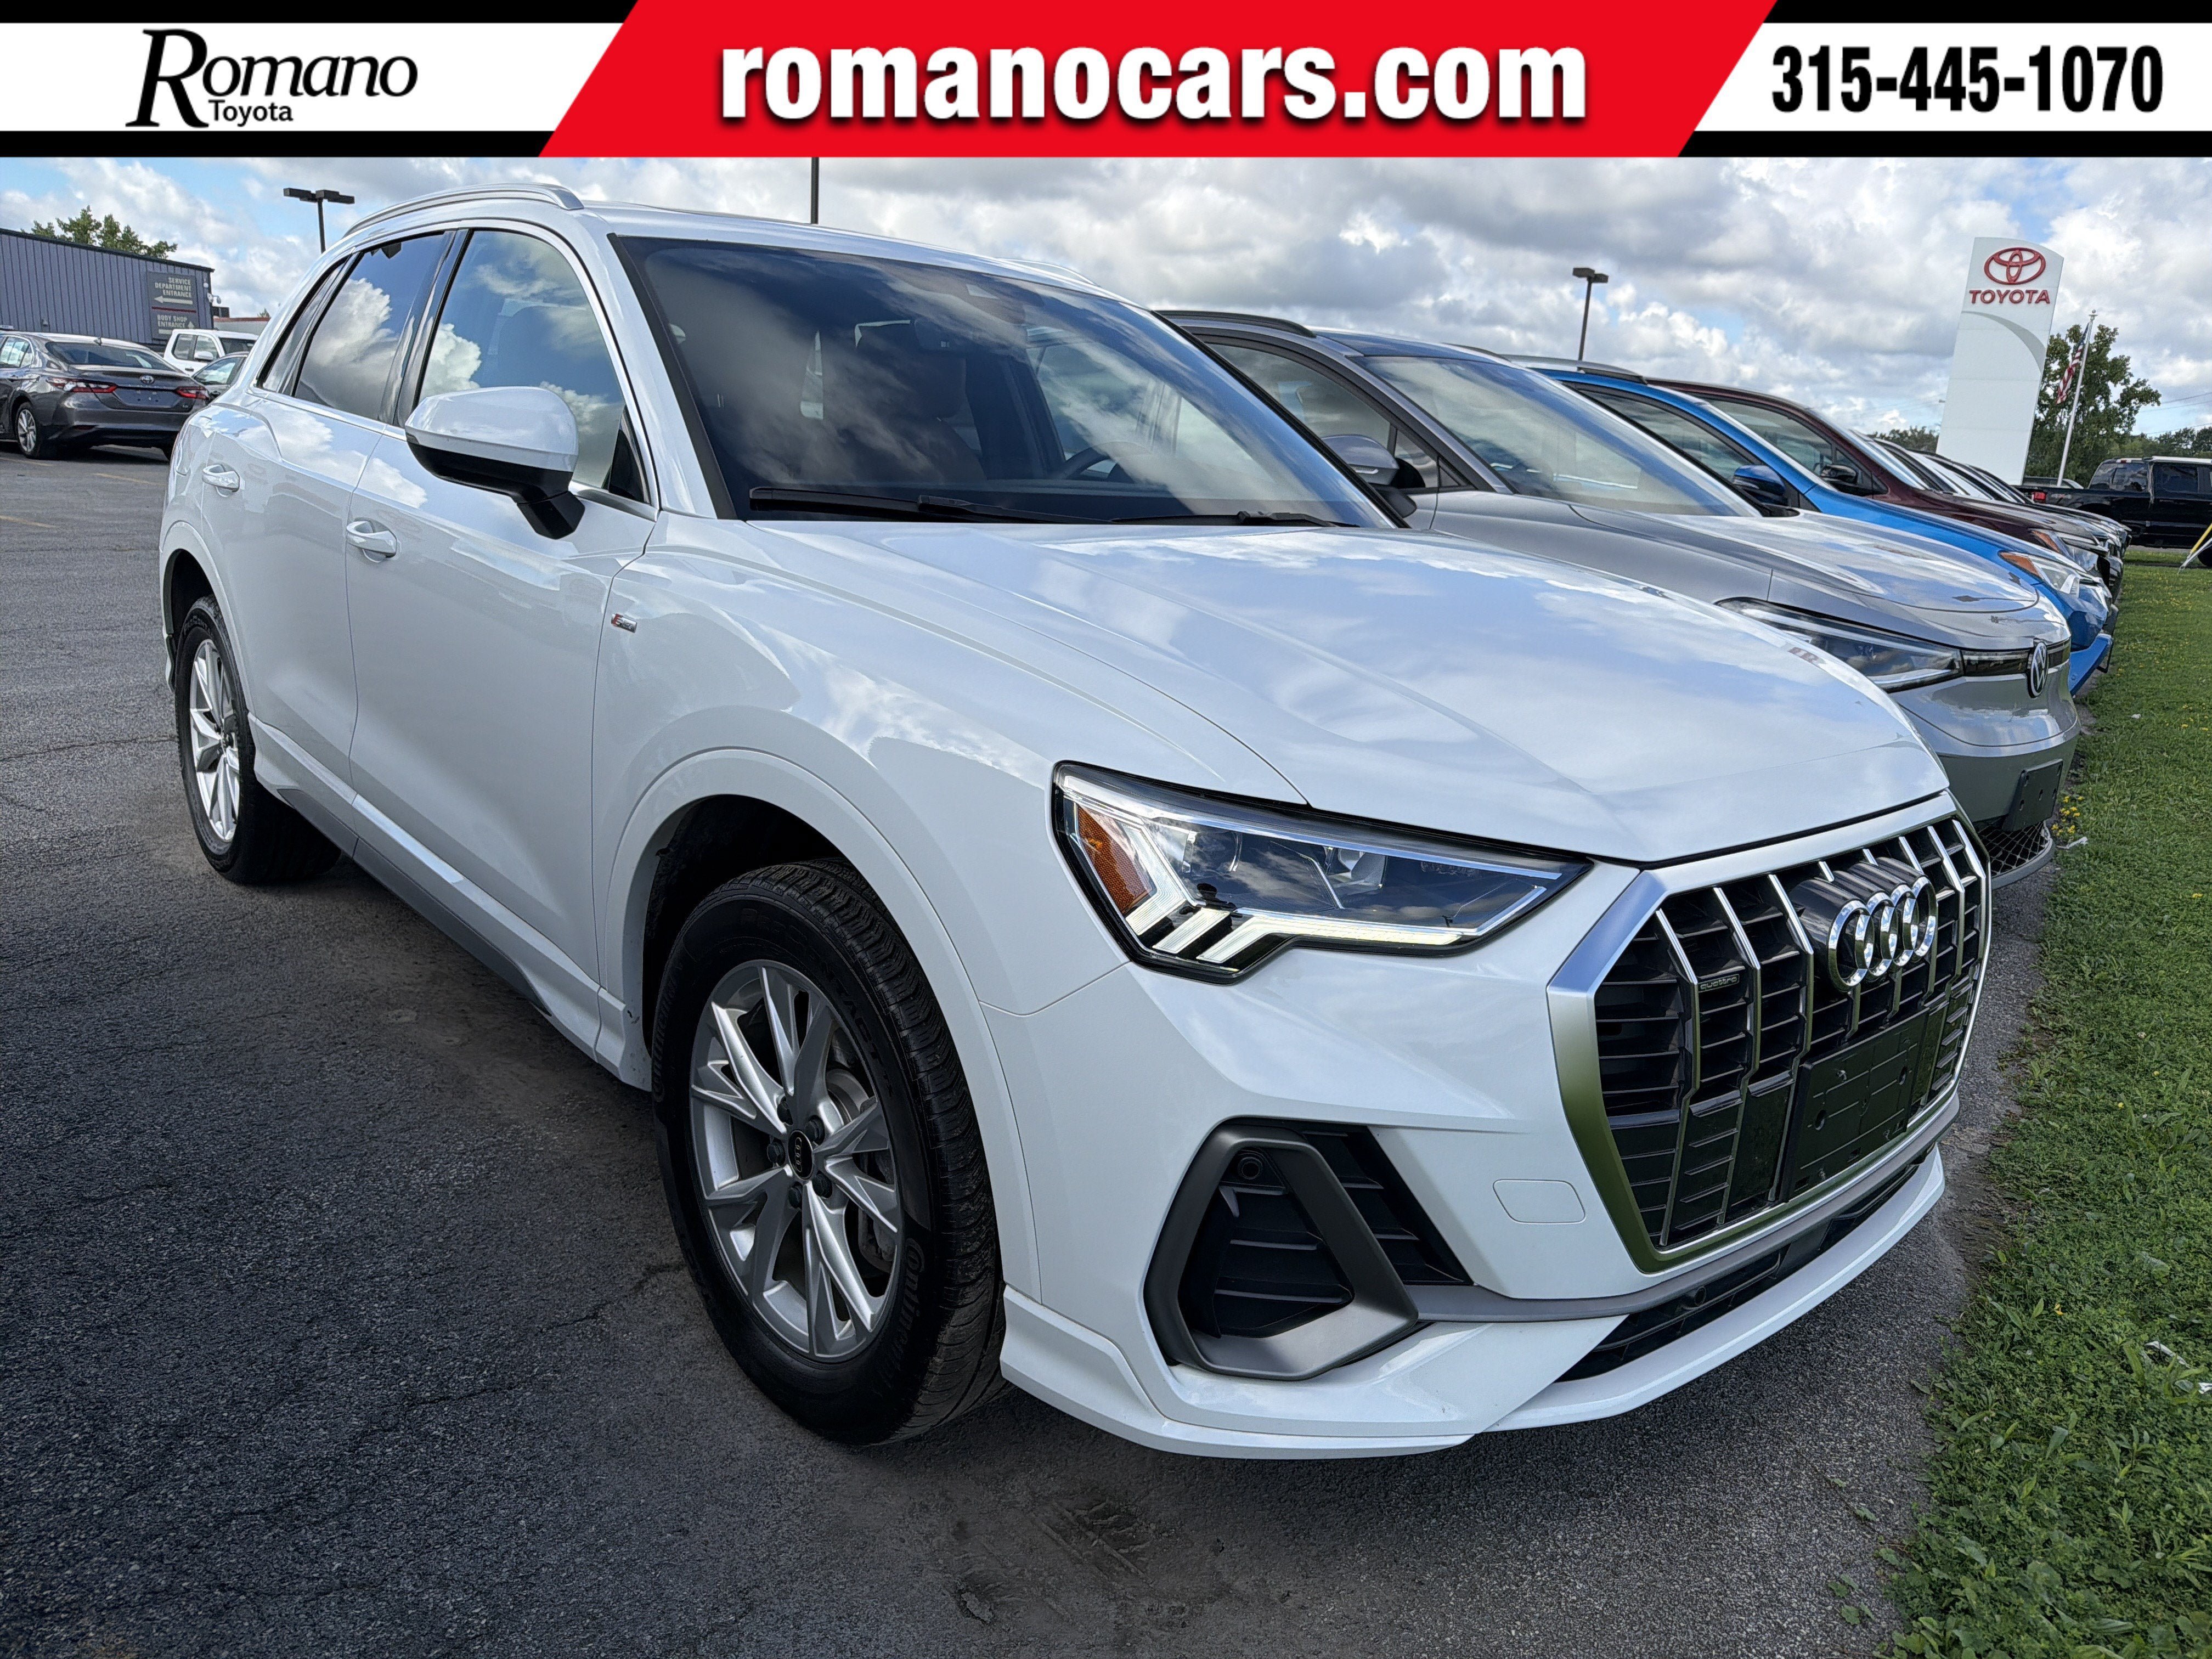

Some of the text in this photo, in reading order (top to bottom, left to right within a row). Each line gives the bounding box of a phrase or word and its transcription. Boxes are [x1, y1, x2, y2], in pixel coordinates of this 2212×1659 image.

[168, 277, 191, 285] SERVICE
[155, 282, 191, 291] DEPARTMENT
[162, 290, 191, 298] ENTRANCE
[1969, 289, 2051, 304] TOYOTA
[1700, 977, 1737, 990] quattro
